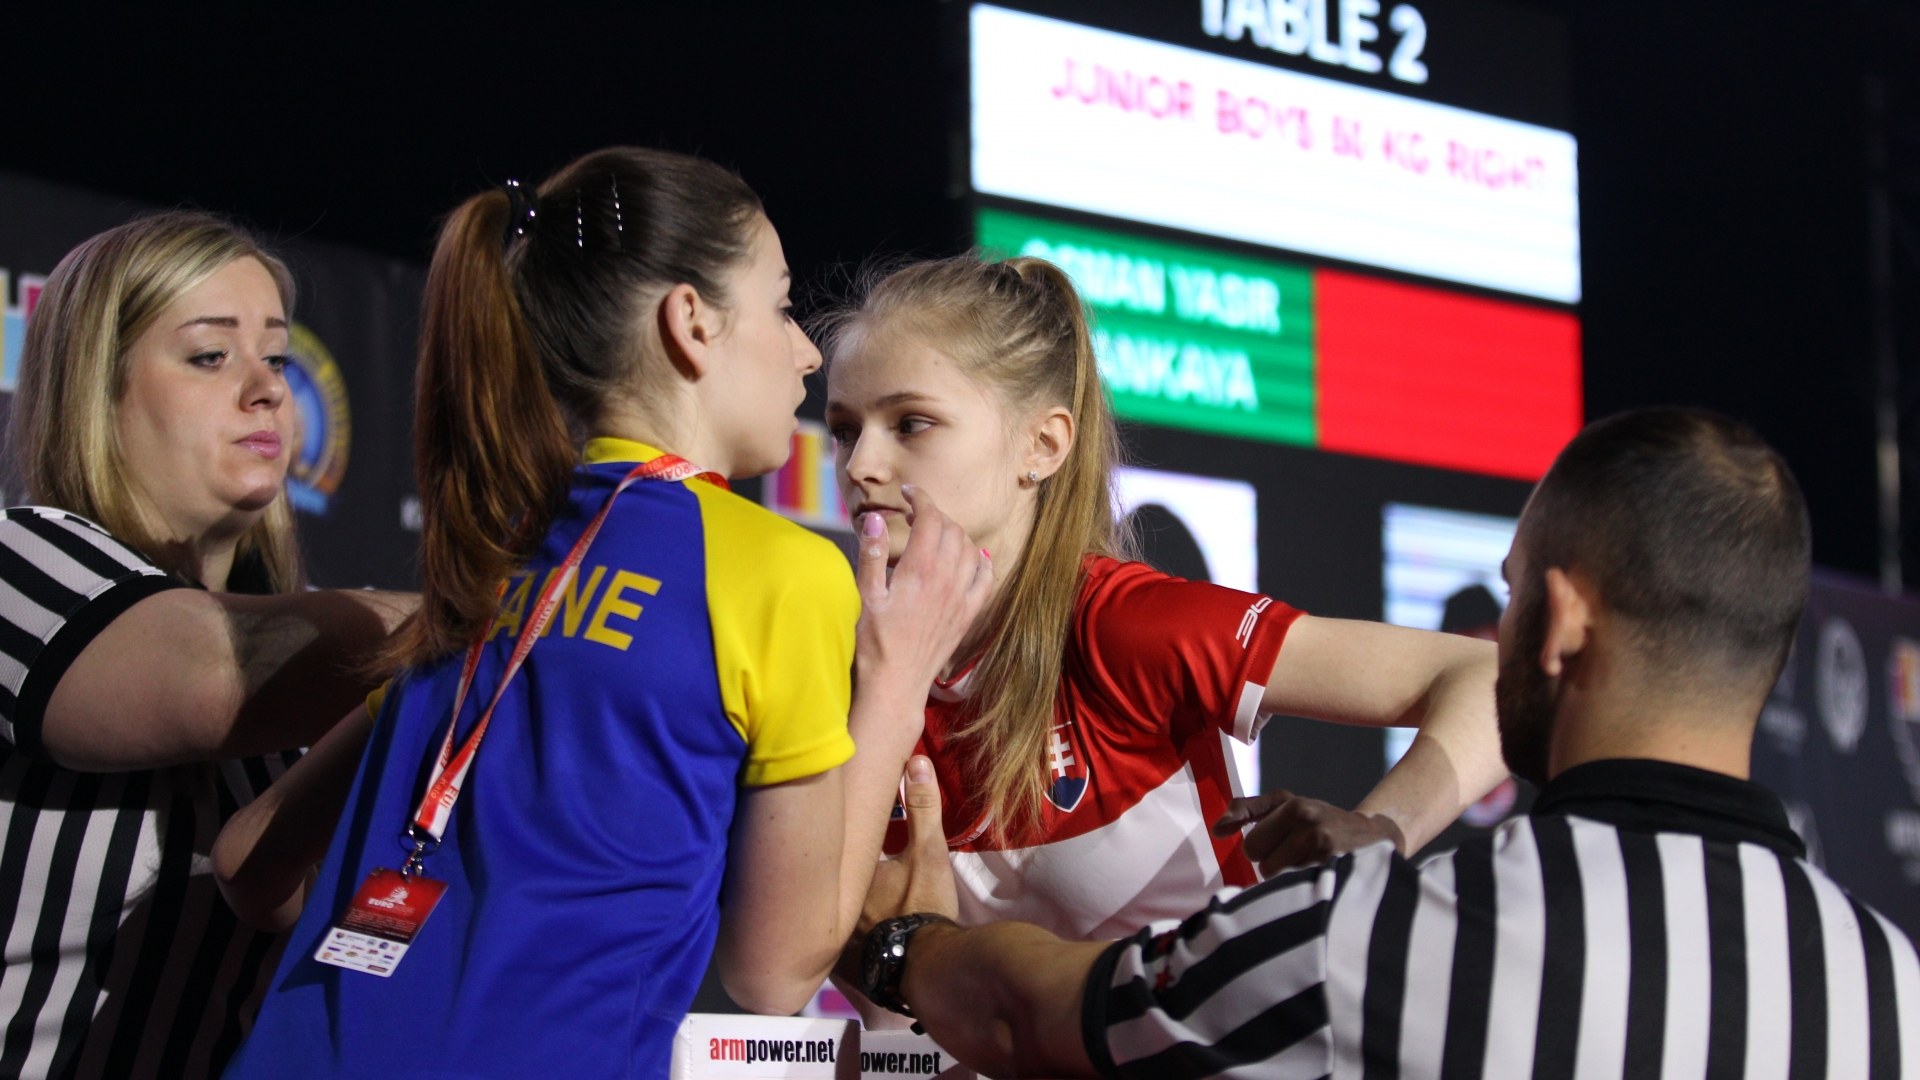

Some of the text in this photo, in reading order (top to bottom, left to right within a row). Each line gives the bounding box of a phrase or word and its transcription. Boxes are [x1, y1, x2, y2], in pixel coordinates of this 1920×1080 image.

[1389, 4, 1429, 84] 2
[1051, 57, 1196, 120] JUNIOR
[709, 1037, 835, 1064] armpower.net
